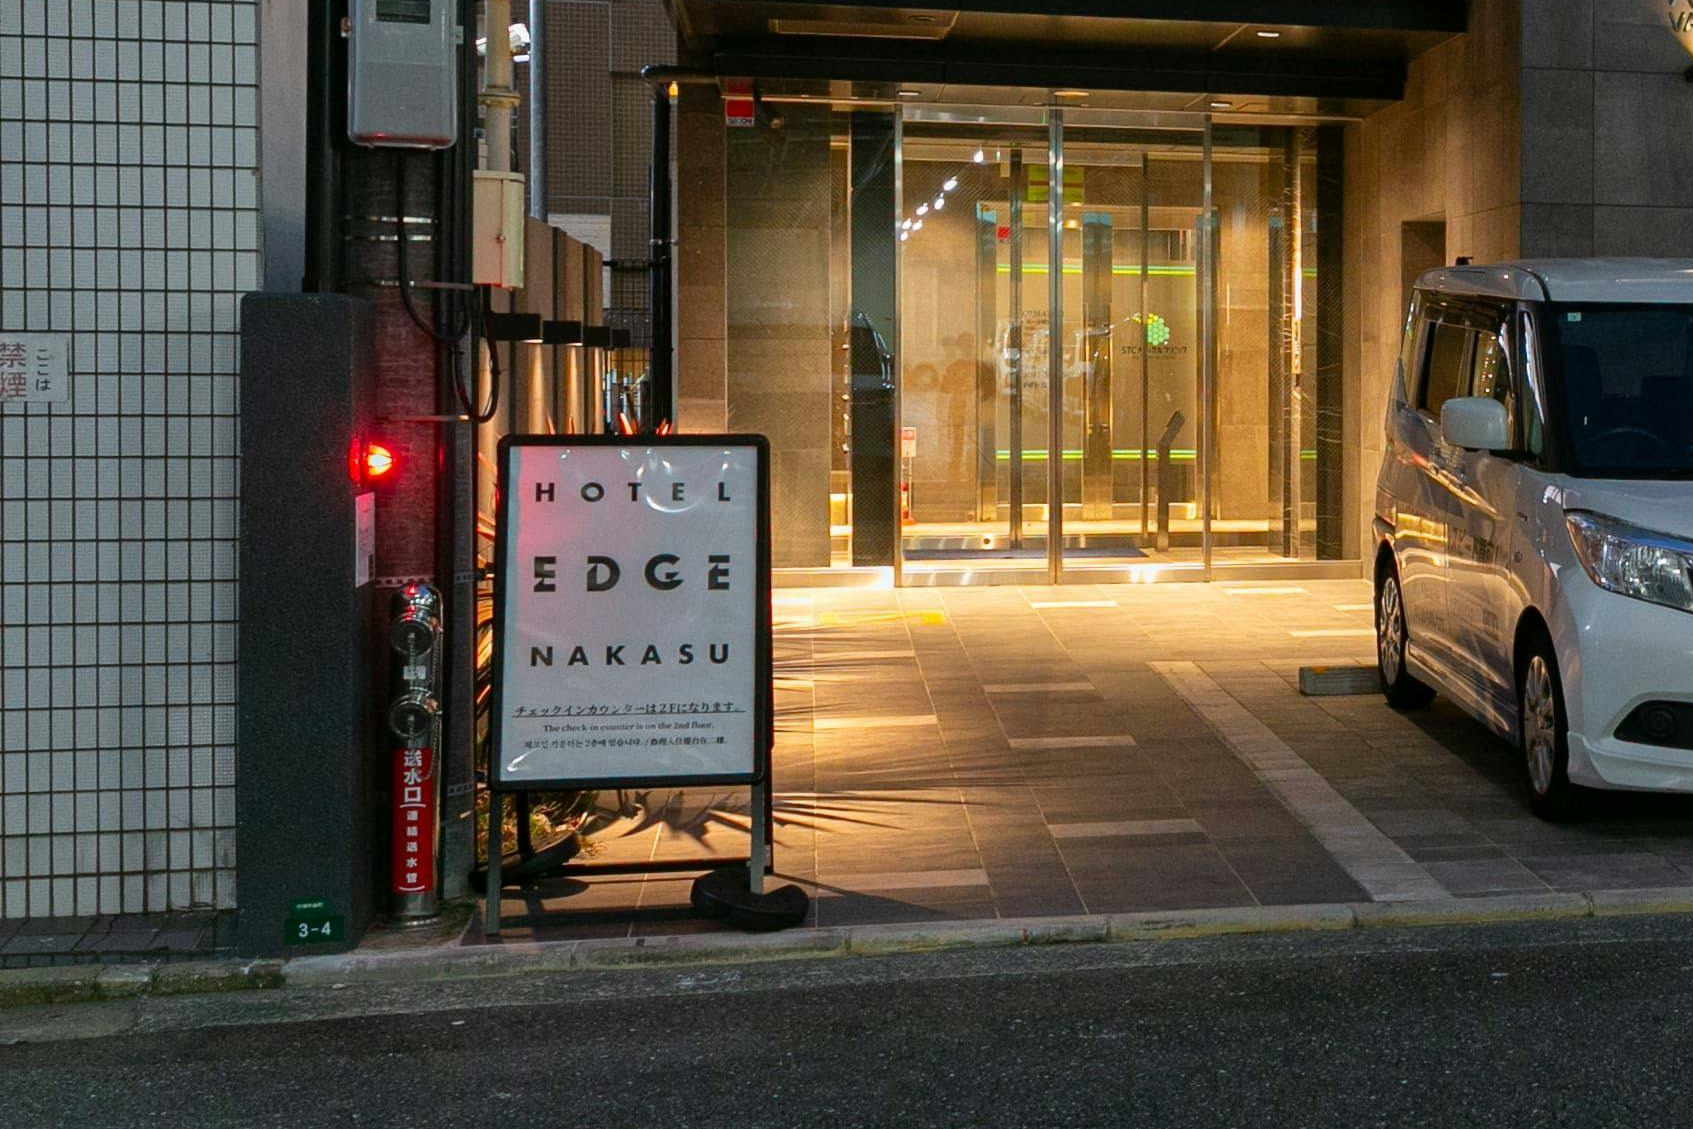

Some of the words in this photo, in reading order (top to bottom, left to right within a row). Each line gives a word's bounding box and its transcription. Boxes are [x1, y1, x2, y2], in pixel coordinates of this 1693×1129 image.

[35, 348, 52, 392] ここは
[535, 481, 731, 503] HOTEL
[533, 553, 731, 593] EDGE
[530, 643, 729, 667] NAKASU
[543, 724, 560, 732] The
[600, 723, 634, 731] counter
[645, 722, 657, 730] on
[657, 721, 672, 730] the
[673, 721, 690, 730] 2nd
[691, 720, 715, 730] floor.
[403, 750, 423, 803] 送水口
[298, 921, 332, 938] 3-4
